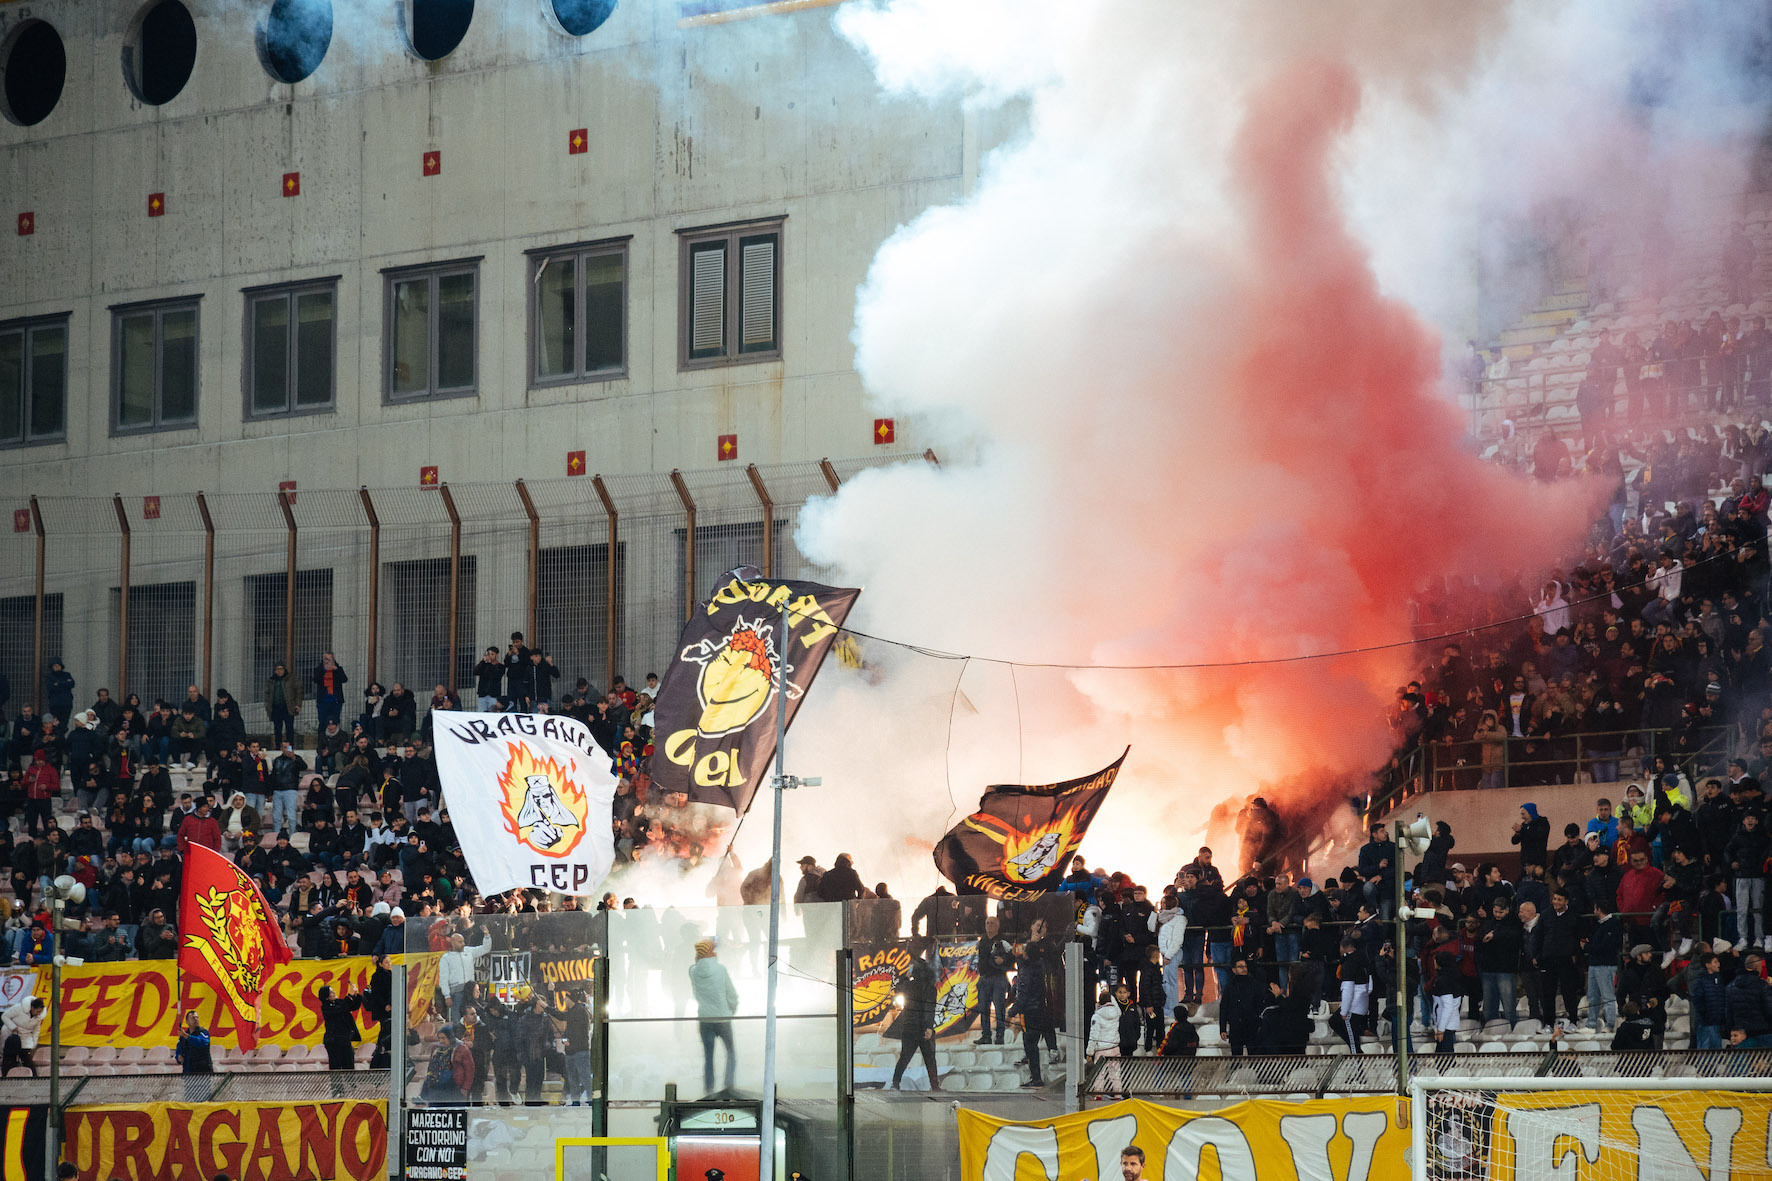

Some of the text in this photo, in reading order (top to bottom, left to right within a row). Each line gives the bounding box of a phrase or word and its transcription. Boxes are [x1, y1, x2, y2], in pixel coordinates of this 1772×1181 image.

[530, 864, 588, 892] CEP
[411, 1113, 463, 1128] MARESCA E
[64, 1102, 388, 1181] URAGANO
[408, 1129, 466, 1145] CENTORRINO
[416, 1146, 456, 1163] CON NOI
[408, 1165, 463, 1179] URAGANO CEP
